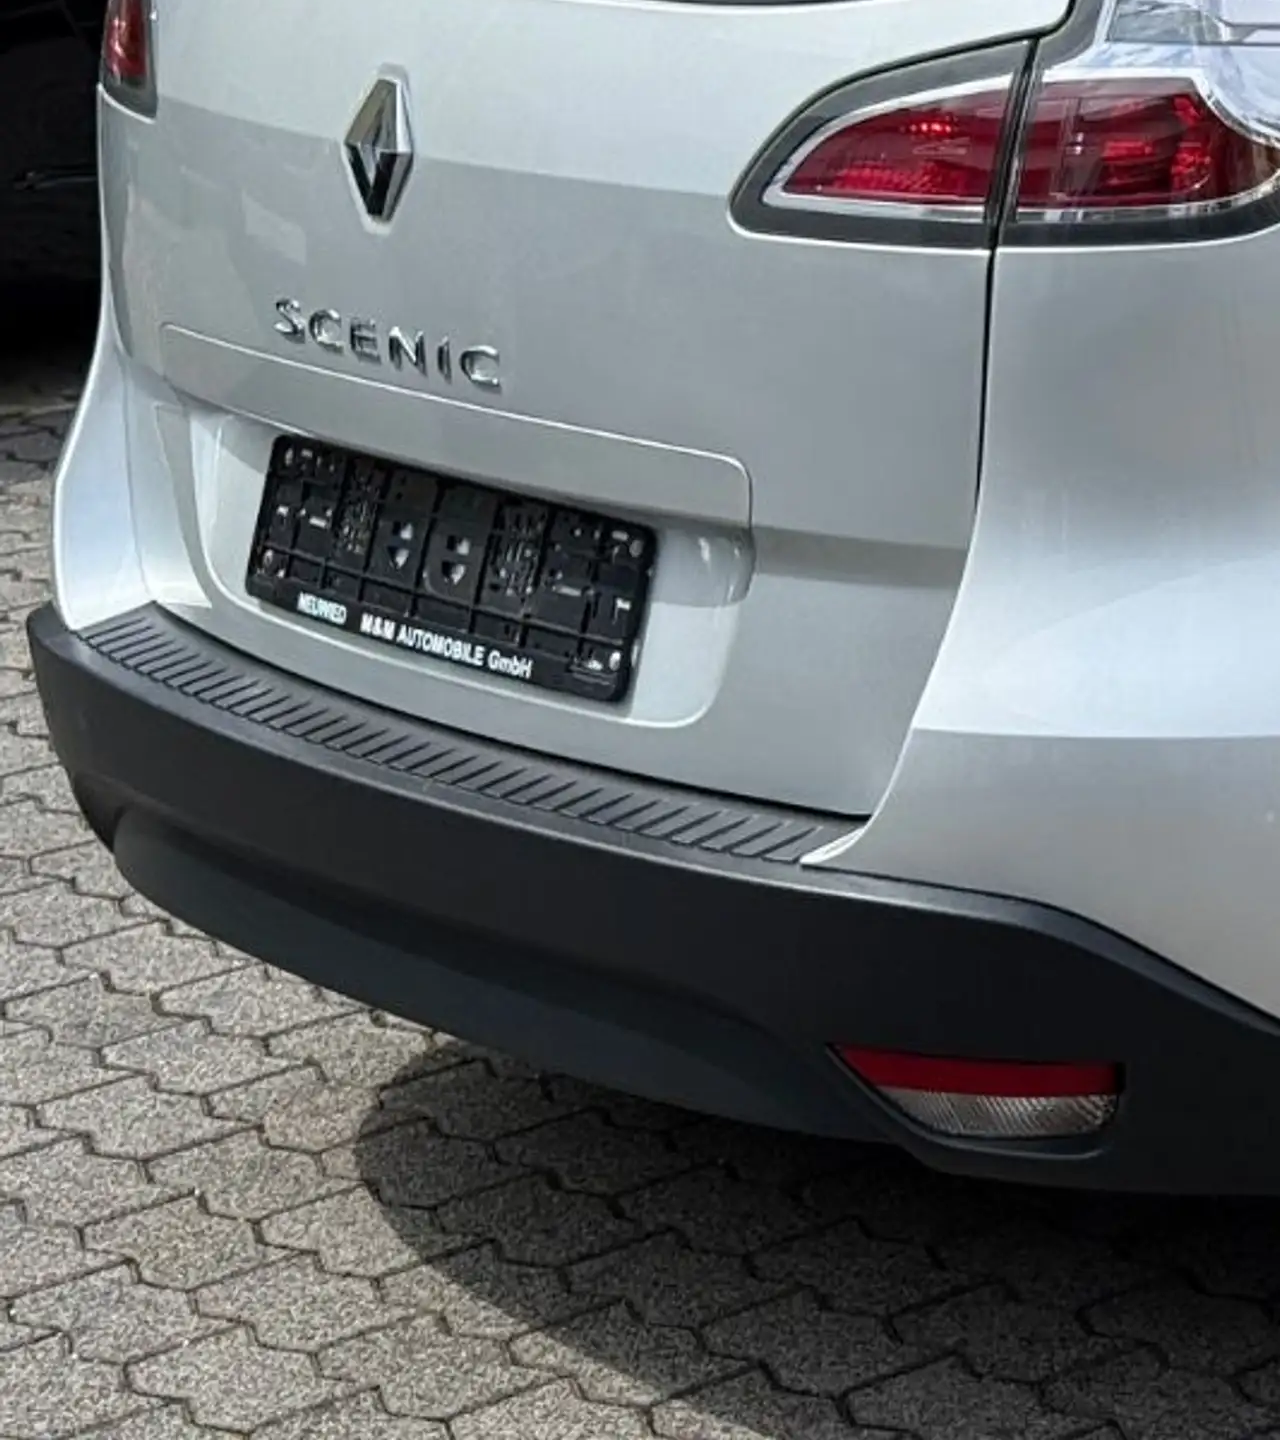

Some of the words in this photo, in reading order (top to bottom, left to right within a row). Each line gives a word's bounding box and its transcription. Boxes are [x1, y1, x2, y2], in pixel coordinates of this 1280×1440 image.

[273, 297, 501, 389] SCENIC
[297, 592, 347, 625] NEUWIED
[360, 613, 396, 640] M&M
[396, 624, 485, 666] AUTOMOBILE
[487, 650, 533, 679] GmbH
